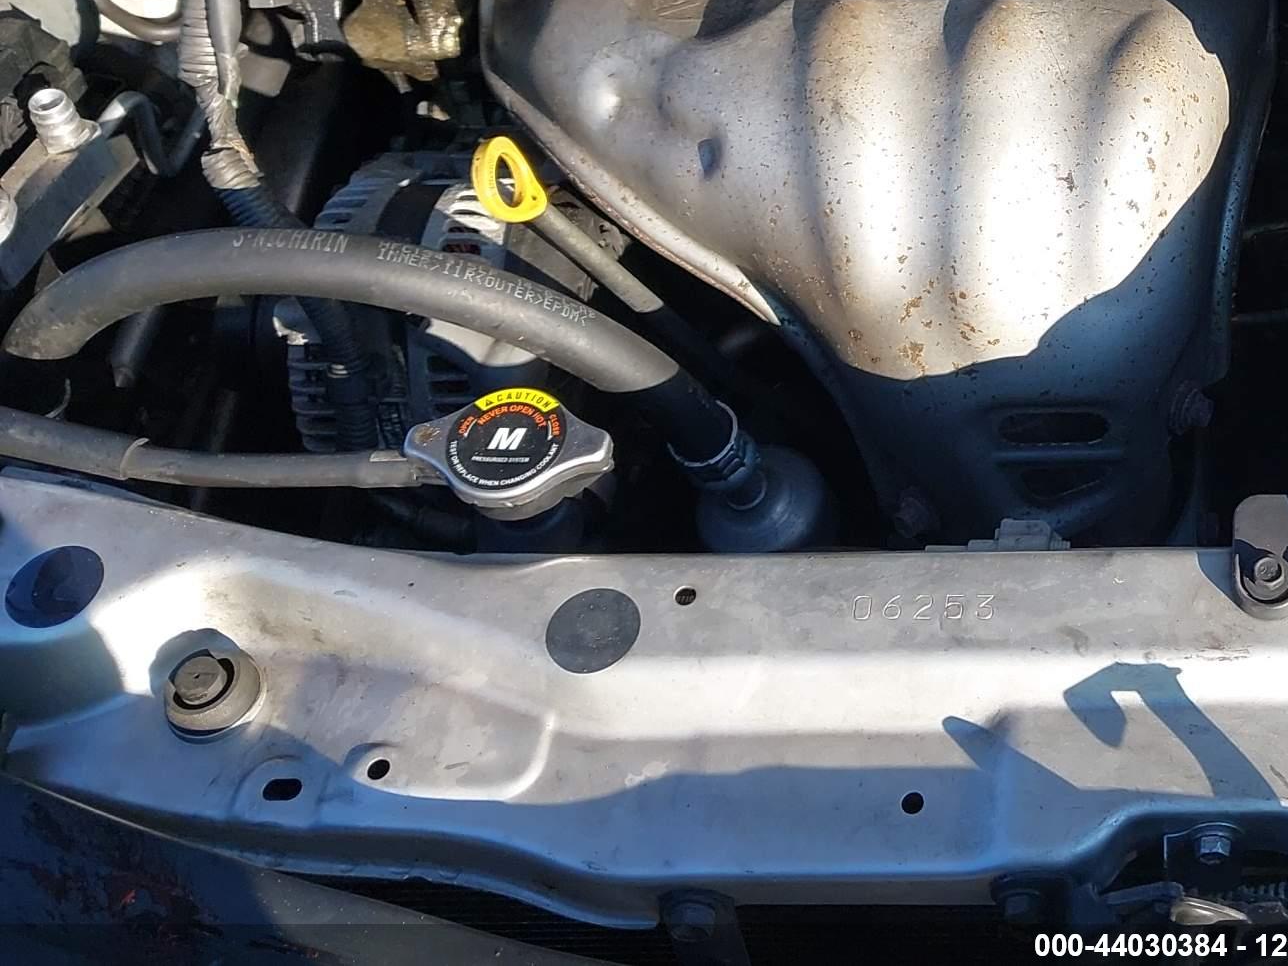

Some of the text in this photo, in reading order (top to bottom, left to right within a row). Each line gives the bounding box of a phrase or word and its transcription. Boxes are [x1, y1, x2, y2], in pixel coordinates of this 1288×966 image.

[497, 392, 551, 408] CAUTION
[477, 405, 508, 425] NEVER
[509, 405, 535, 414] OPEN
[487, 428, 528, 450] M
[454, 463, 479, 483] REPLACE
[500, 469, 536, 485] CHANGING
[537, 443, 559, 470] COOLANT
[852, 594, 996, 621] 06253
